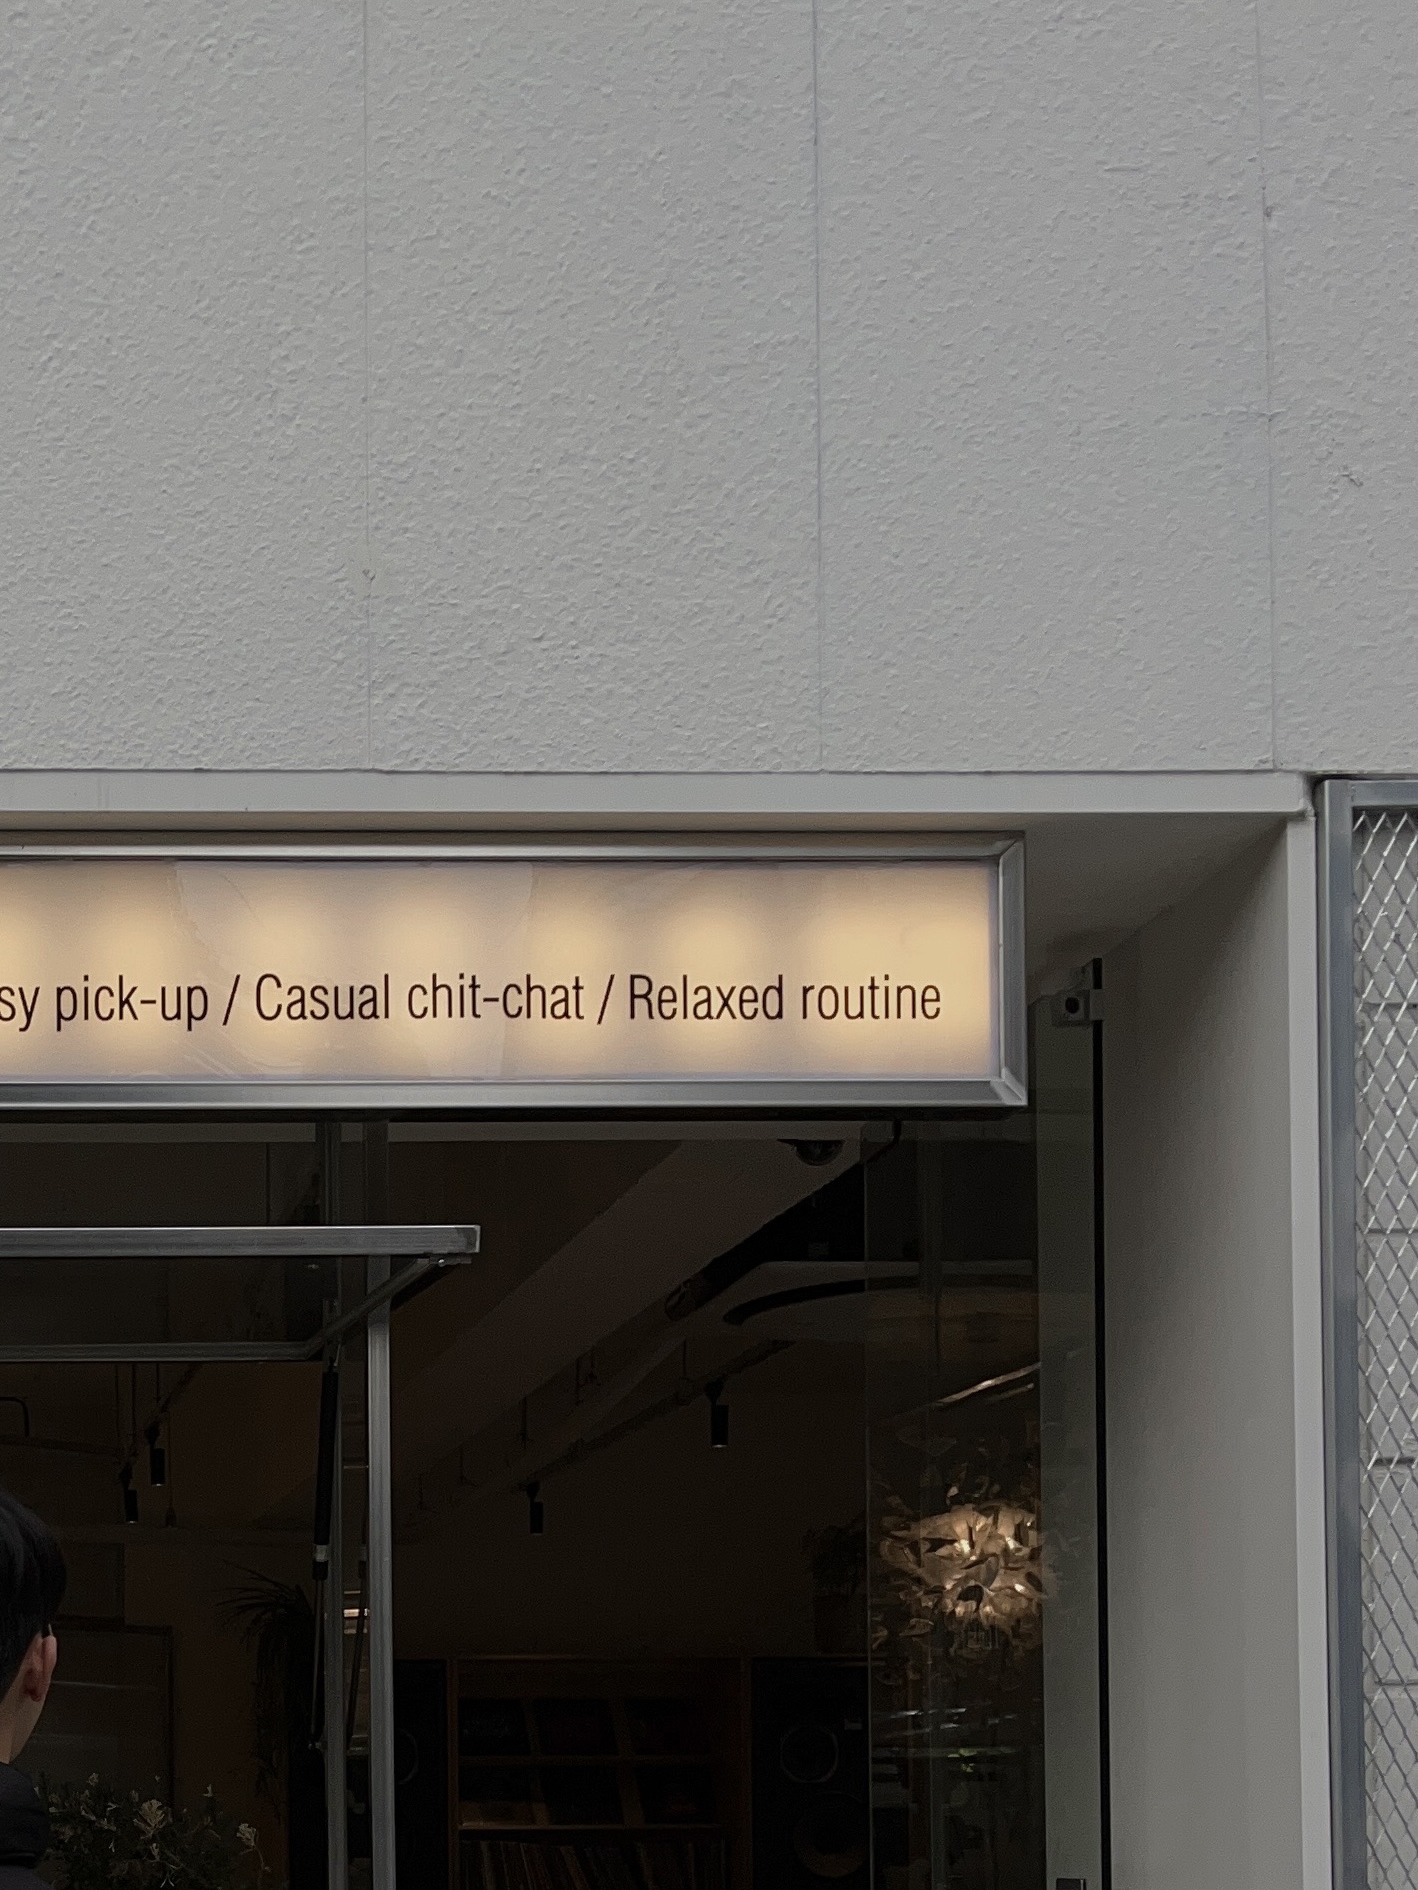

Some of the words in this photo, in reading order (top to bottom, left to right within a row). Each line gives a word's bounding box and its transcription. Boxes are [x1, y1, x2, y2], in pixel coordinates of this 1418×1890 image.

[56, 974, 208, 1032] pick-up
[256, 973, 389, 1021] Casual
[408, 973, 585, 1020] chit-chat
[629, 974, 784, 1020] Relaxed
[802, 974, 941, 1020] routine
